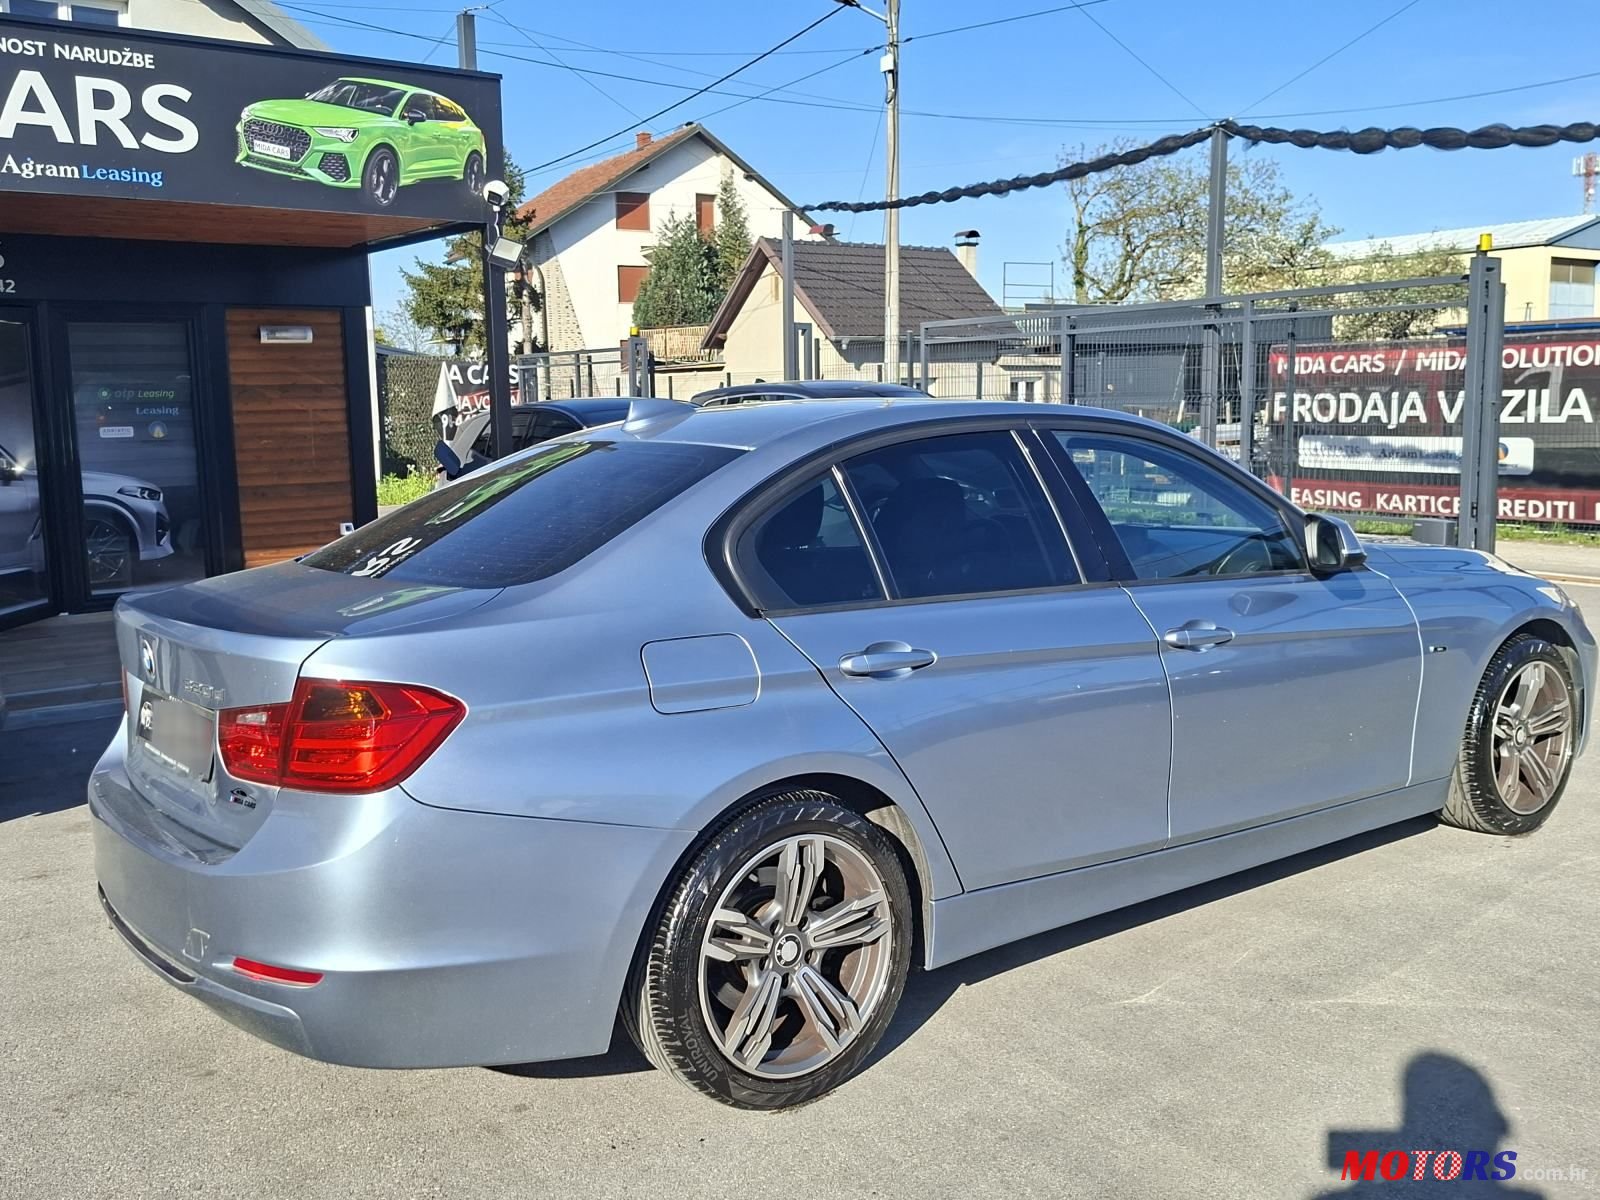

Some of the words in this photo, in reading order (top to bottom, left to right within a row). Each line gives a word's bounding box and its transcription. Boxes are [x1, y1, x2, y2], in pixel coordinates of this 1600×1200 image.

[54, 43, 155, 69] NARUDŽBE
[1330, 354, 1385, 374] CARS
[1502, 345, 1600, 369] OLUTIO
[137, 388, 176, 400] Leasing
[1437, 388, 1593, 424] VZILA
[136, 405, 179, 416] Leasing
[1290, 487, 1362, 509] EASING
[1498, 498, 1576, 520] REDITI
[678, 1008, 718, 1081] UNIROYAL
